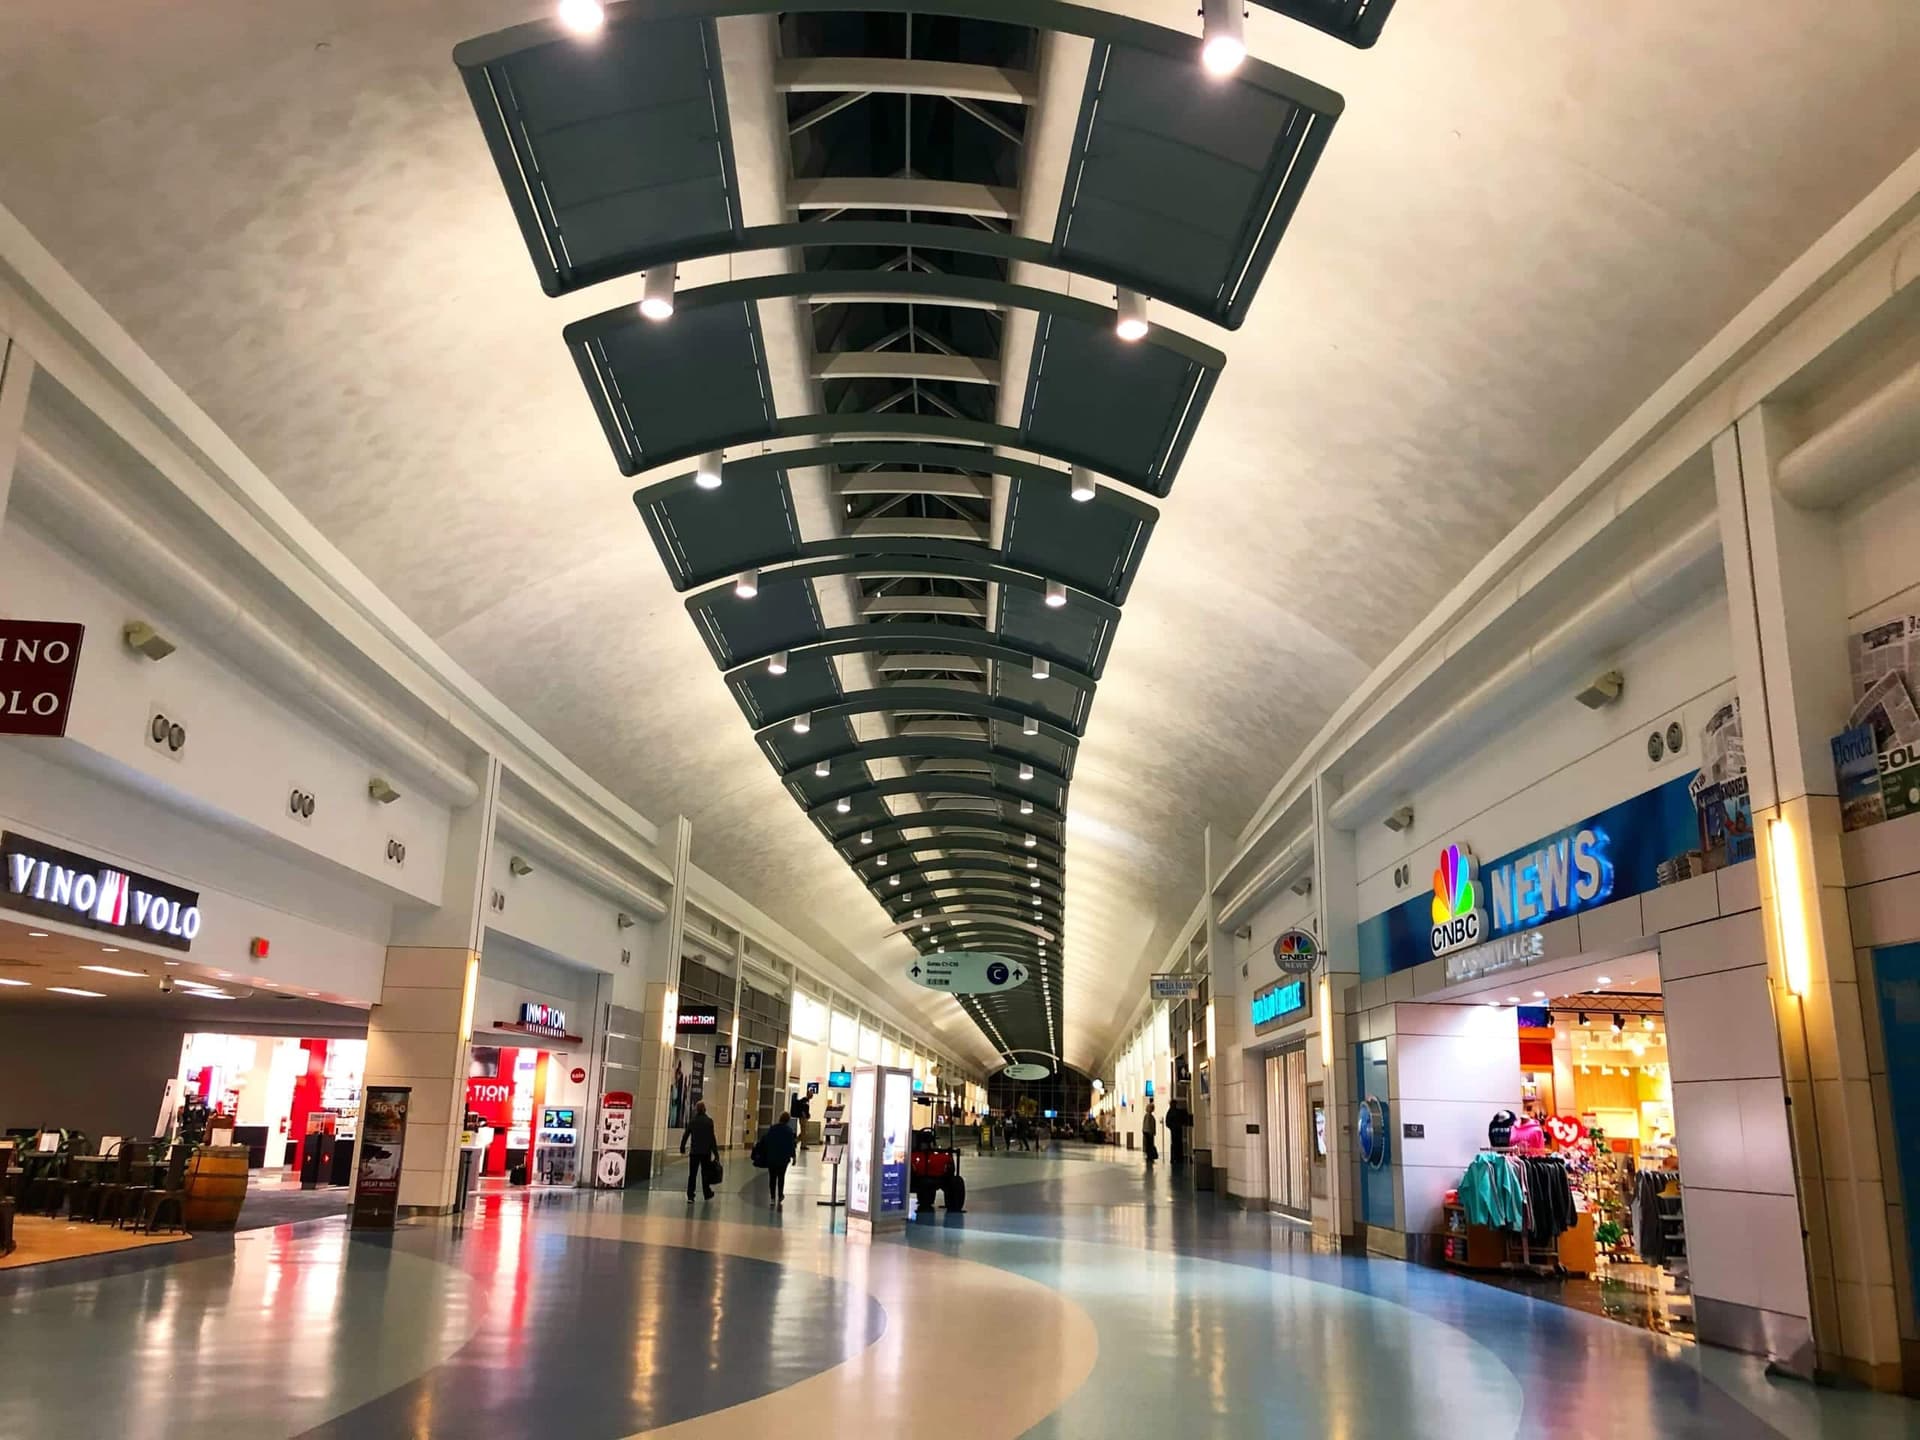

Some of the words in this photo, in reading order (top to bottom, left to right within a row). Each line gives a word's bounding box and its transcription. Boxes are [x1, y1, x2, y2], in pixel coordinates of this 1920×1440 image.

[1491, 829, 1601, 930] NEWS
[8, 853, 97, 912] VINO
[130, 890, 201, 940] VOLO
[1431, 913, 1478, 951] CNBC
[1279, 953, 1313, 961] CNBC
[993, 969, 1002, 980] C
[1548, 1117, 1578, 1142] ty
